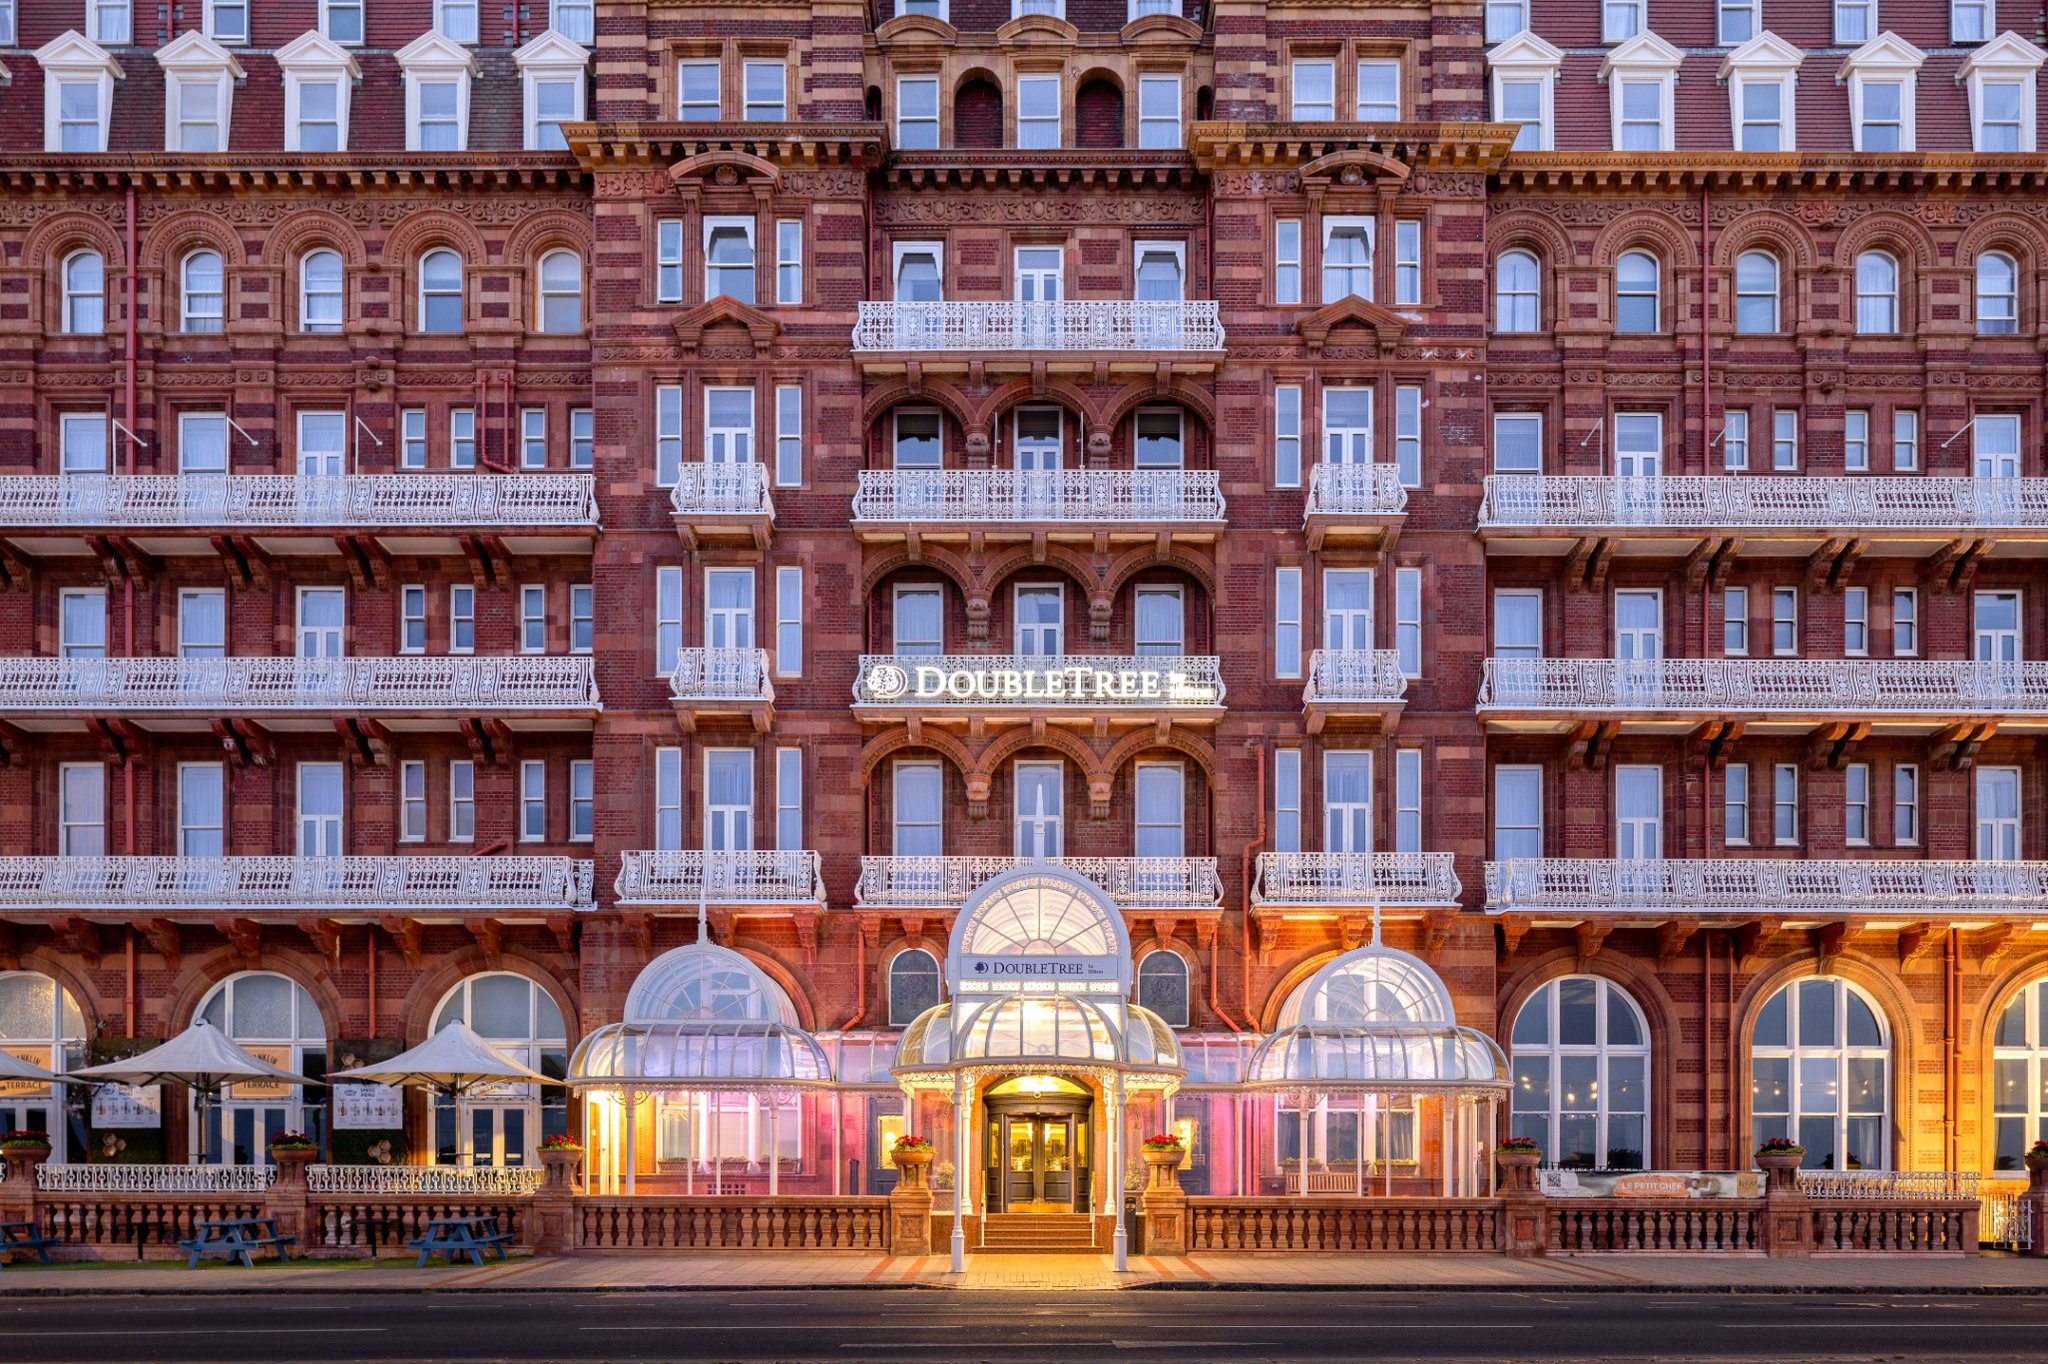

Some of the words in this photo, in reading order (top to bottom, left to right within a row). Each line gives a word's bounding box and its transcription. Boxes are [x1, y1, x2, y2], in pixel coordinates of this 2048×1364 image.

[243, 1081, 280, 1089] TERRACE
[1622, 1182, 1633, 1190] LE
[1634, 1182, 1658, 1190] PETIT
[1659, 1182, 1682, 1190] CHEF
